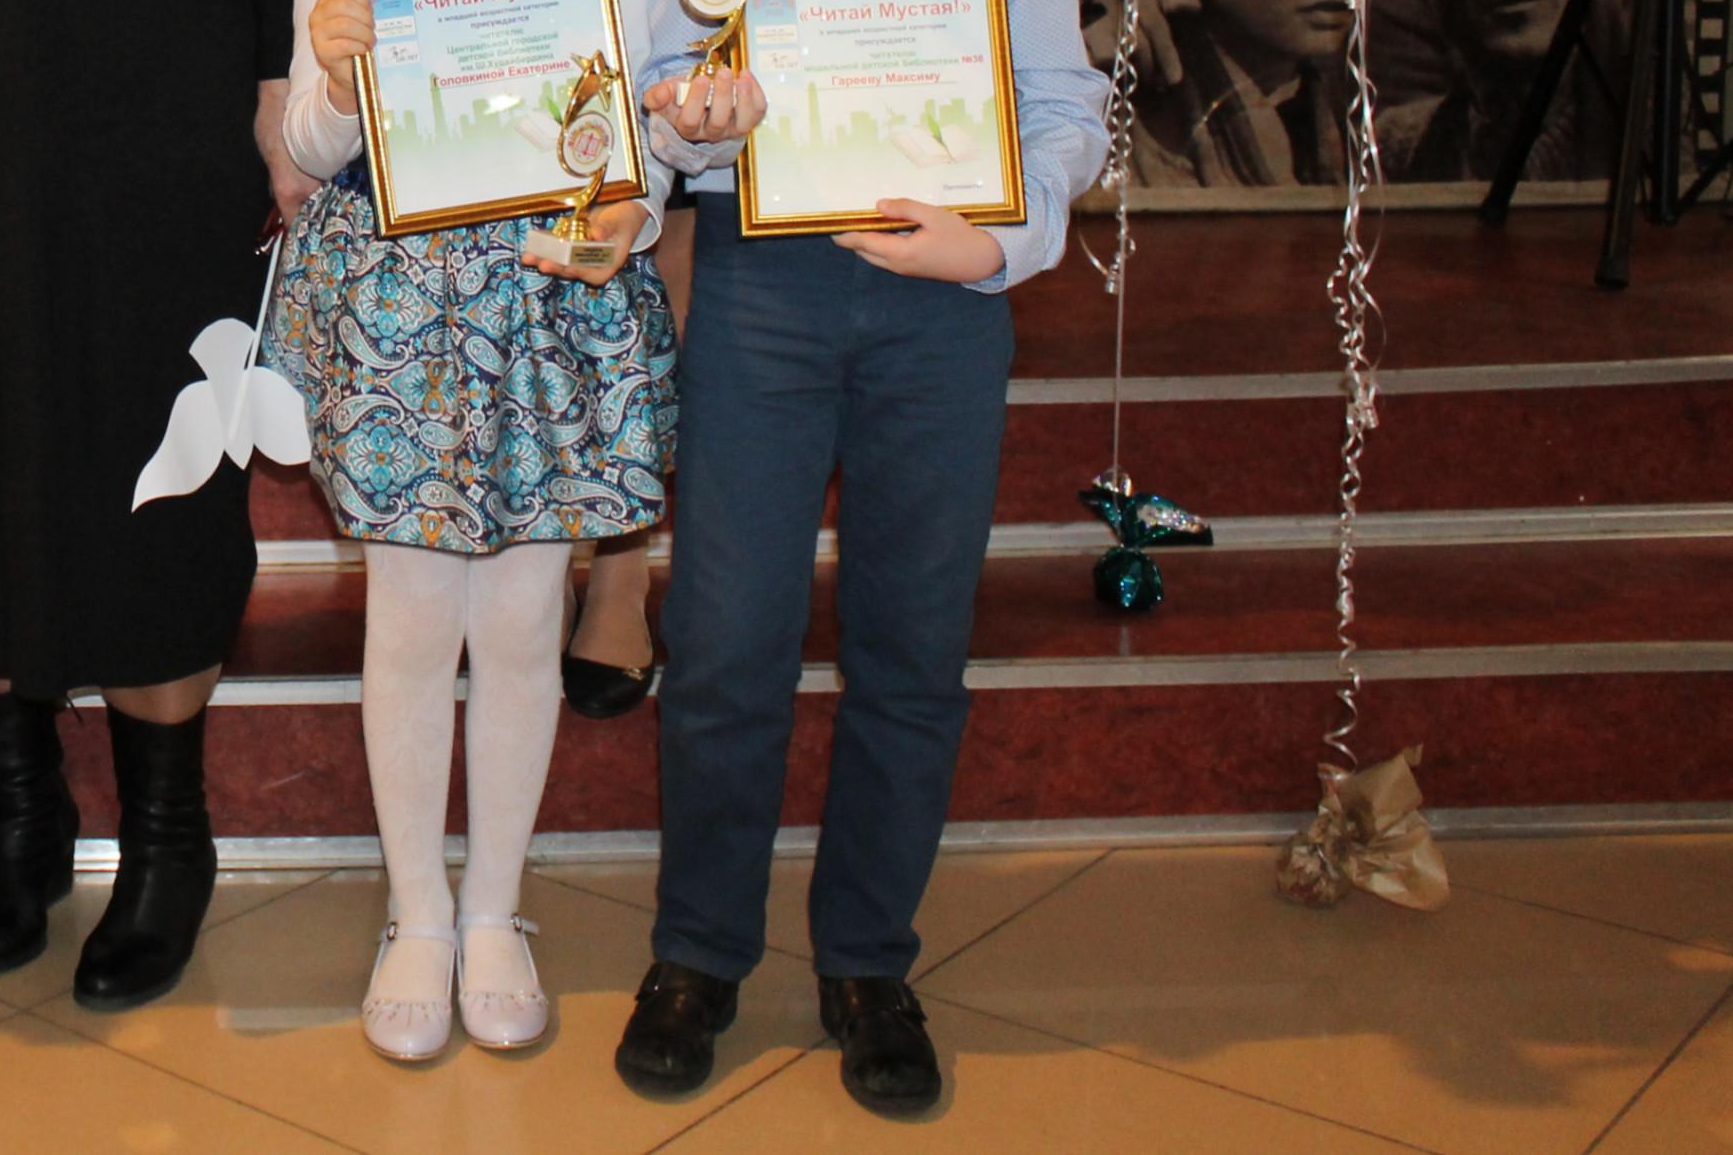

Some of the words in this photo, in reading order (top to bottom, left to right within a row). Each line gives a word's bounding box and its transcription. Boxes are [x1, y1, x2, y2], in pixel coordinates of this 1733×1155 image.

[798, 3, 872, 23] «Читай
[507, 59, 570, 77] Екатерине
[885, 70, 940, 85] Максиму
